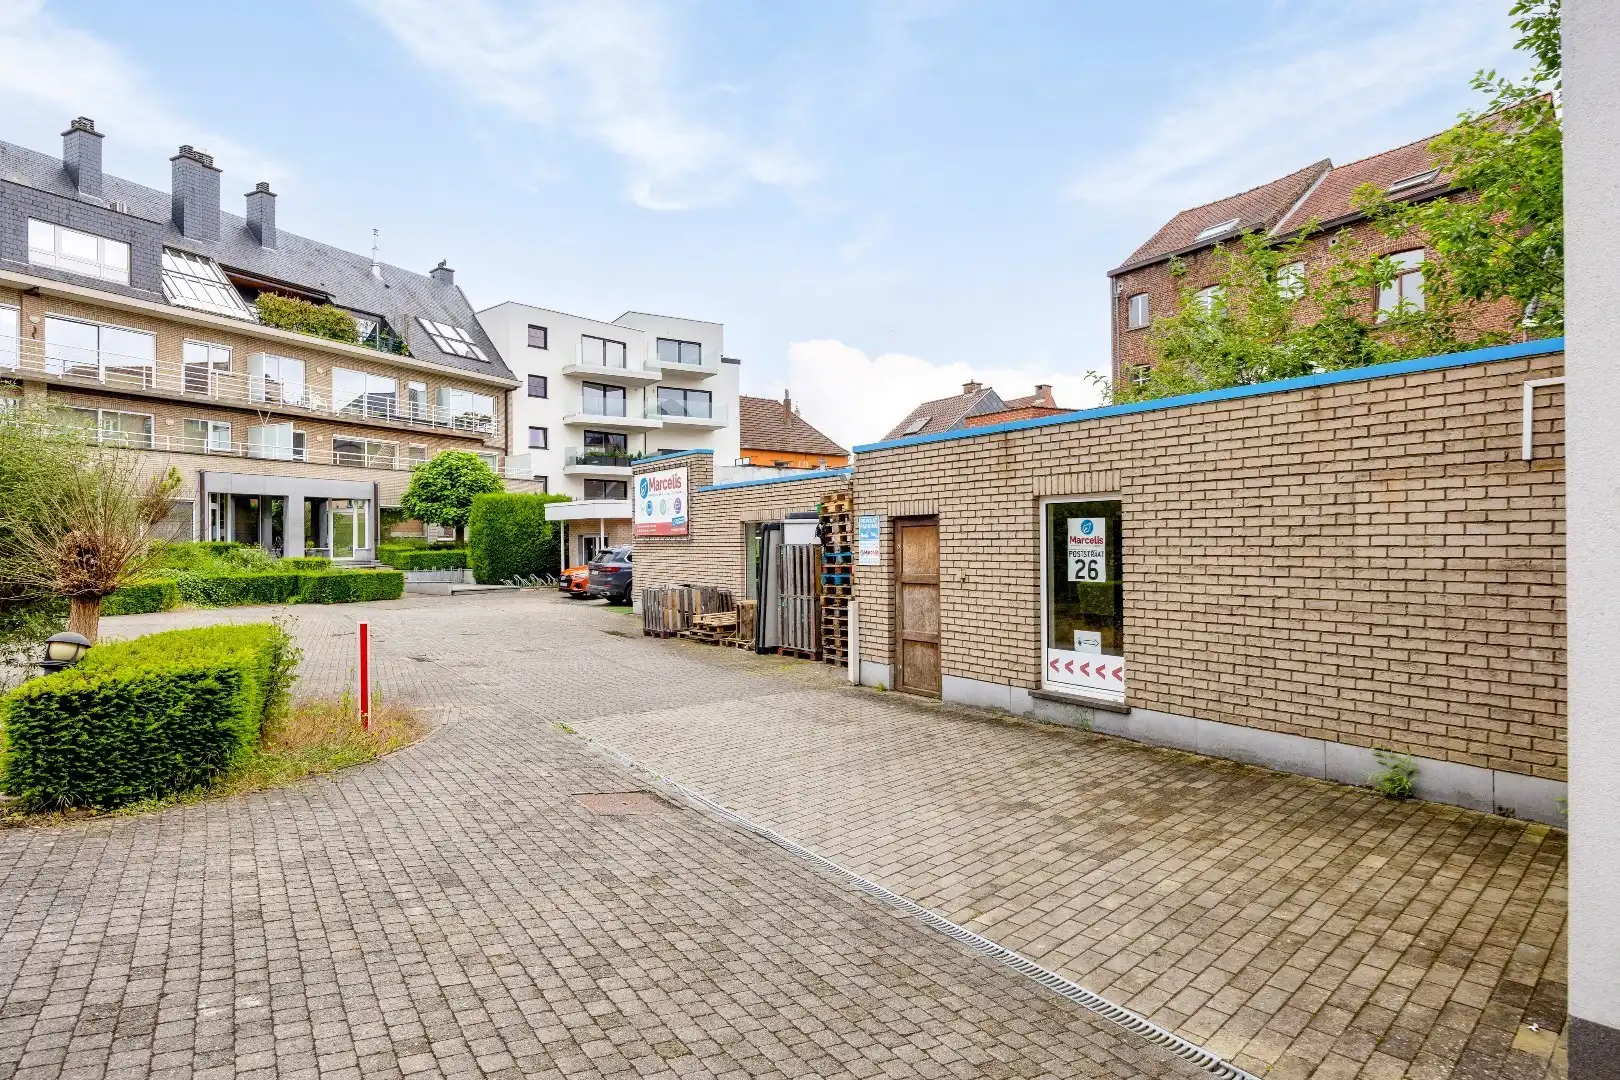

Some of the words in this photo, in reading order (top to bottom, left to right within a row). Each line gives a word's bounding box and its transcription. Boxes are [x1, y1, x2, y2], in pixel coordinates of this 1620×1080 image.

[649, 474, 682, 492] Marcelis
[1070, 536, 1104, 545] Marcelis
[1074, 559, 1099, 580] 26
